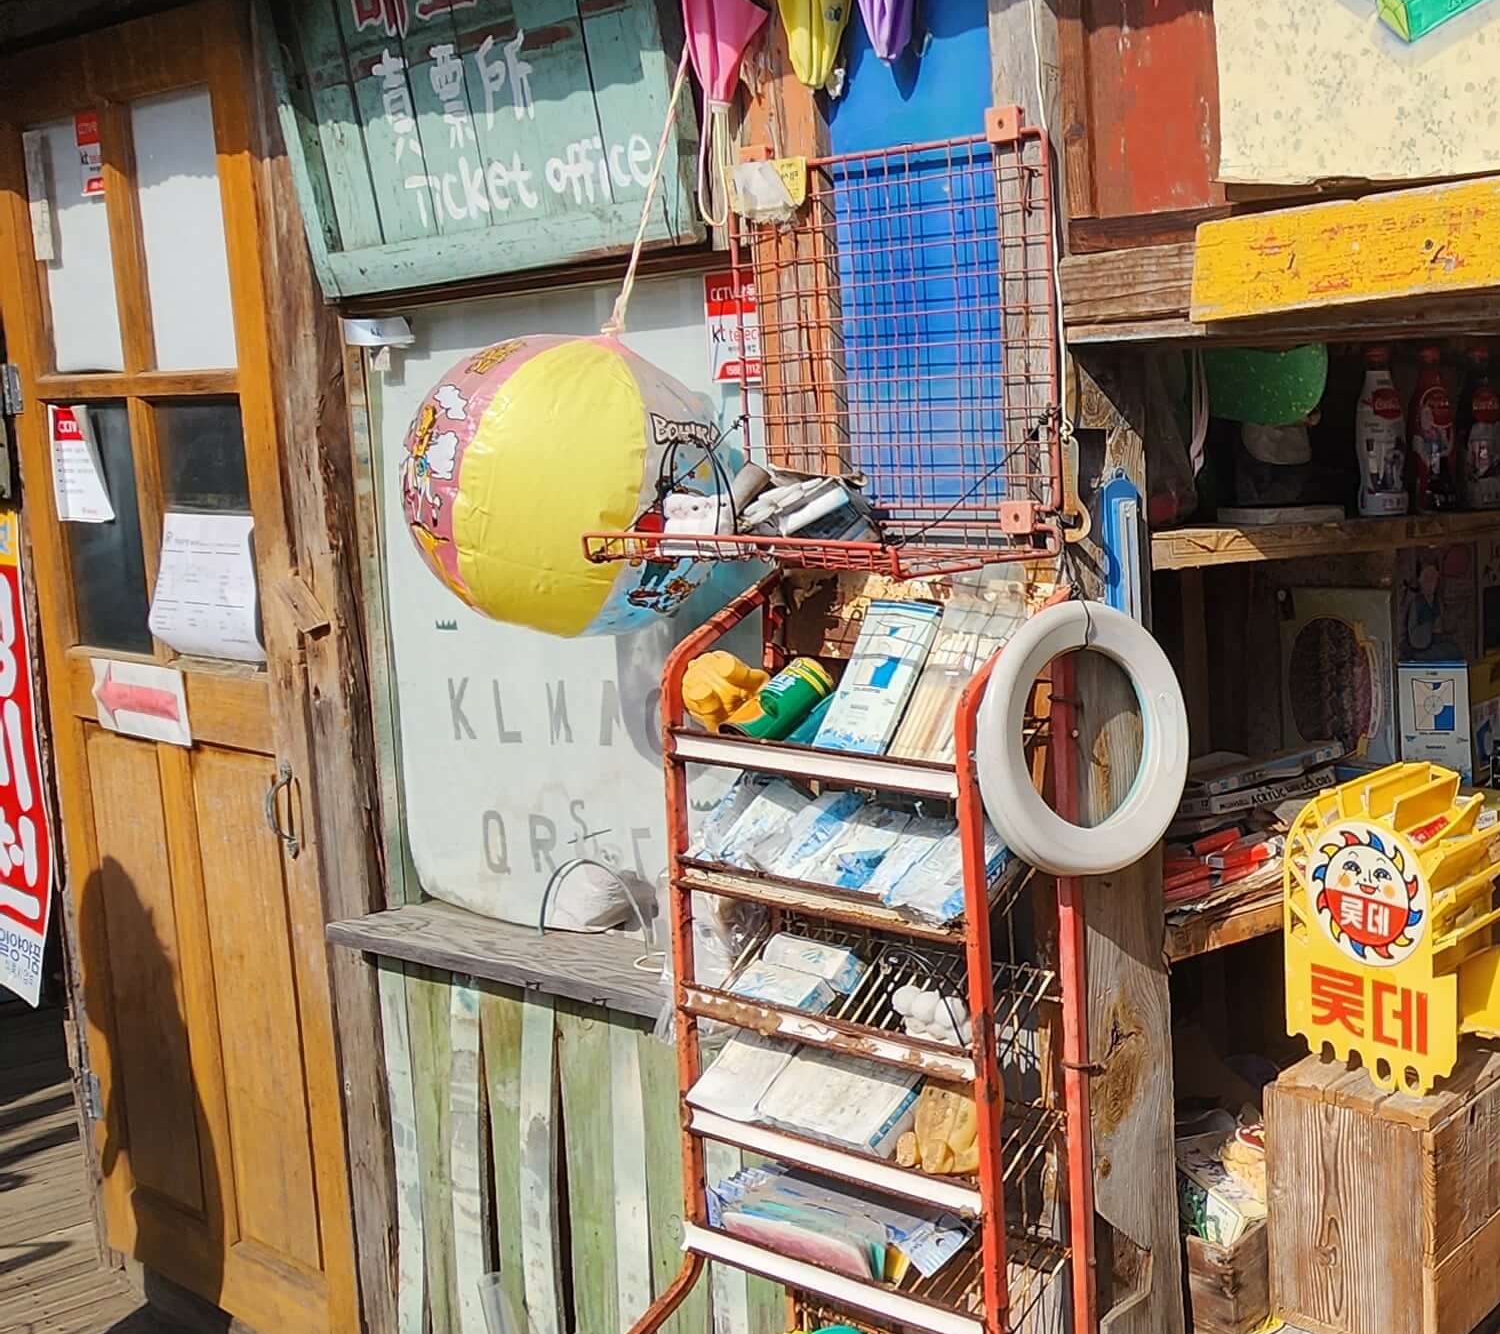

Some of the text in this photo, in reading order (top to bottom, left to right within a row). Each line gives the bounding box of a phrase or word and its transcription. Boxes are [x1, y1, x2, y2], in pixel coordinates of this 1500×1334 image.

[404, 133, 654, 230] Ticket office
[711, 322, 726, 344] kt
[447, 677, 477, 741] K
[492, 678, 523, 744] L
[481, 809, 512, 876] Q
[527, 812, 559, 874] R
[1339, 894, 1391, 938] 롯데
[1310, 962, 1429, 1057] 롯데
